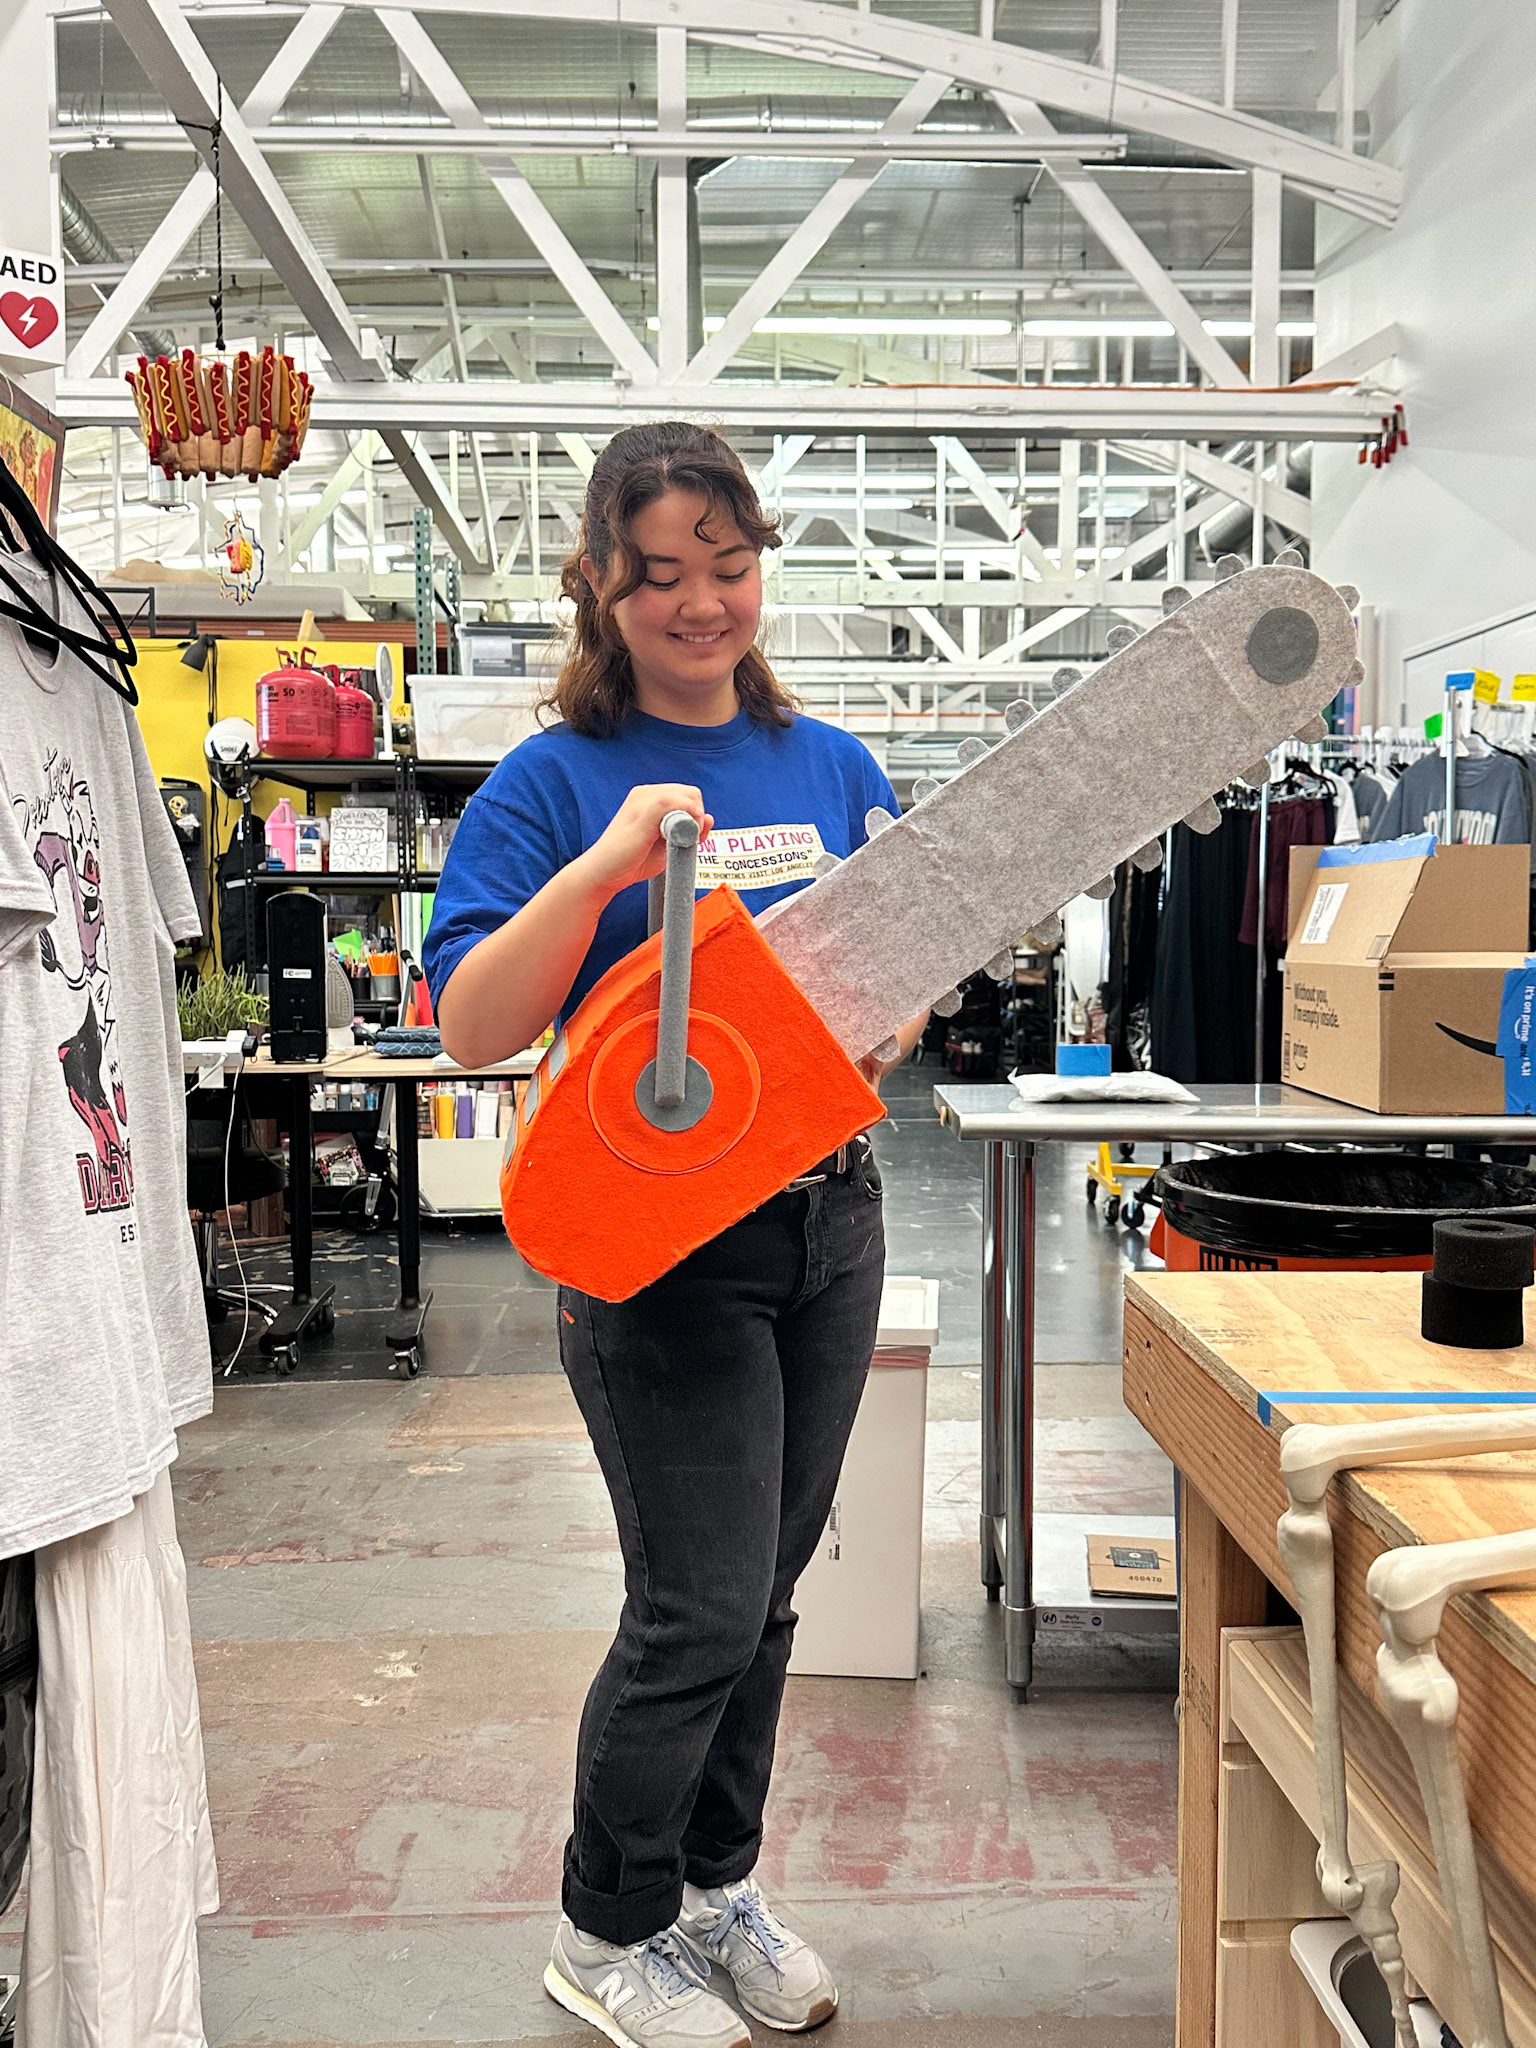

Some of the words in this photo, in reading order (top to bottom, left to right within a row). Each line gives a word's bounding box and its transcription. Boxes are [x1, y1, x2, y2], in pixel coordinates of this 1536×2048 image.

[0, 255, 57, 285] AED
[727, 831, 814, 853] PLAYING
[698, 855, 719, 865] THE
[748, 870, 769, 878] VISIT
[1524, 985, 1535, 1000] It's
[1522, 1001, 1532, 1013] on
[1520, 1014, 1532, 1042] prime
[120, 1223, 138, 1243] ES
